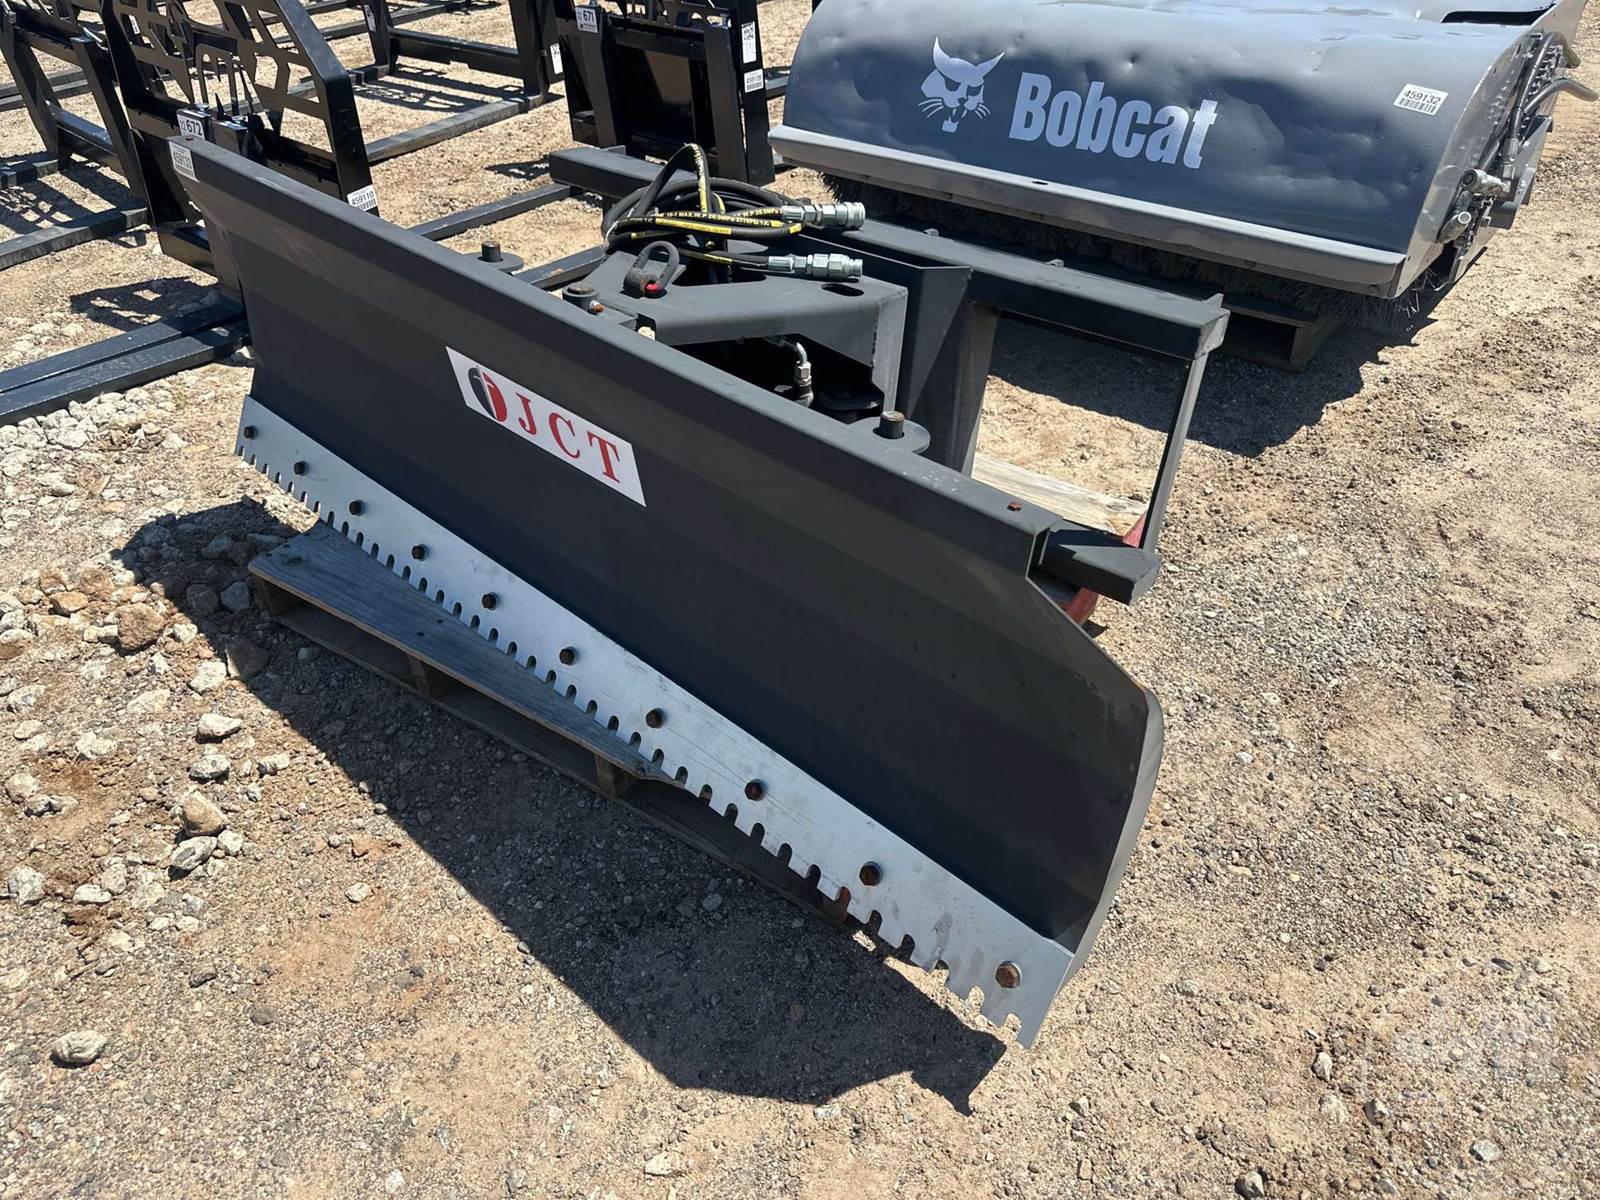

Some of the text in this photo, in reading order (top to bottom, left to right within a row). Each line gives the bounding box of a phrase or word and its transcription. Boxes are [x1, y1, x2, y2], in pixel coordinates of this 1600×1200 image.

[1404, 90, 1441, 106] 459132
[186, 120, 203, 136] 672
[1008, 72, 1218, 169] Bobcat
[351, 190, 375, 206] 459110
[515, 392, 621, 484] JCT
